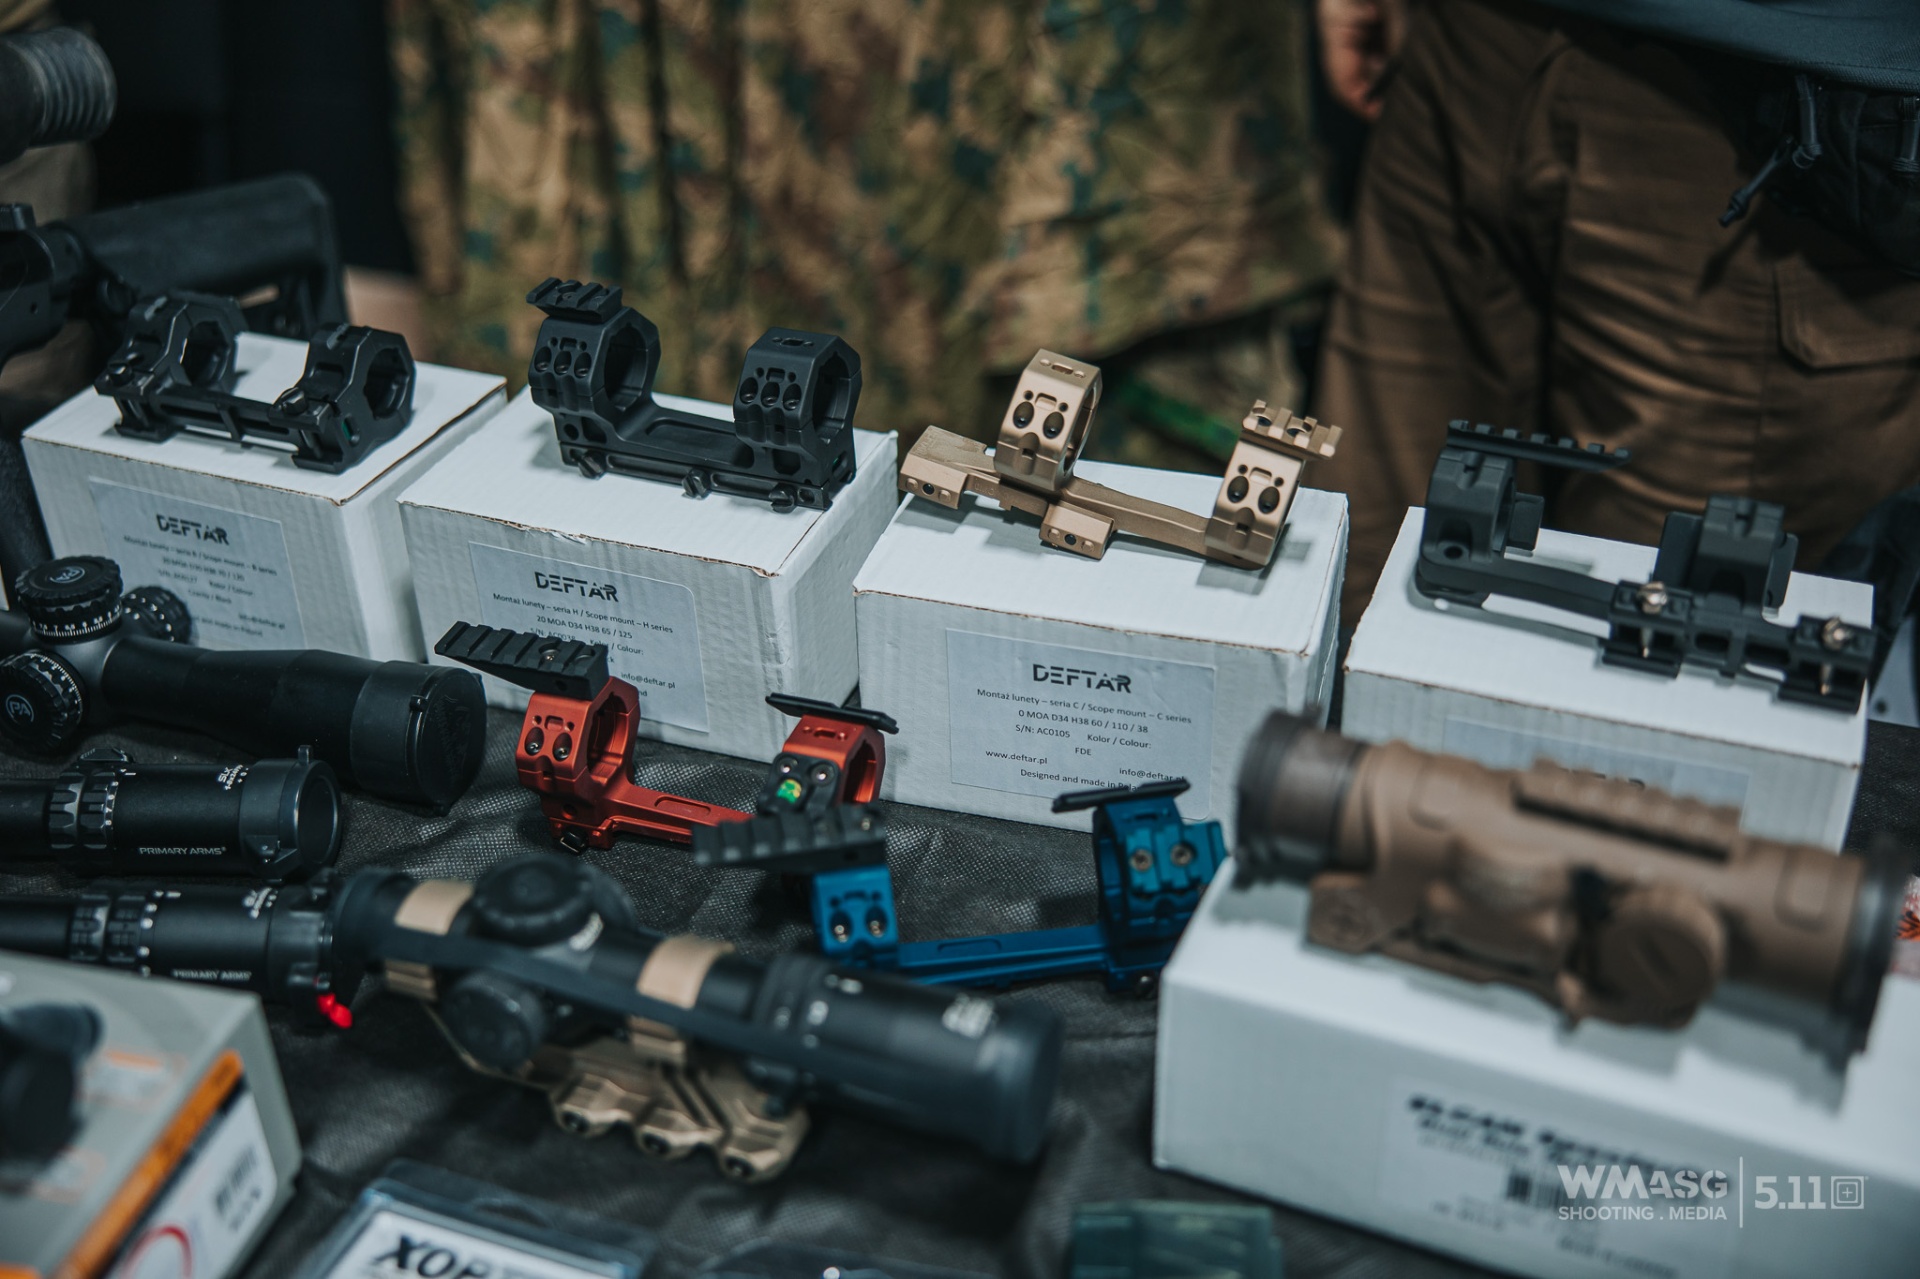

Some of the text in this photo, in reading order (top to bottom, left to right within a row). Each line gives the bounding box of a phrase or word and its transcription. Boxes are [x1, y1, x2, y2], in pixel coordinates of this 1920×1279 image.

[157, 514, 229, 546] DEFTAR
[535, 571, 619, 602] DEFTAR
[522, 599, 546, 610] lunety
[553, 606, 571, 614] seria
[586, 611, 608, 621] Scope
[610, 615, 635, 626] mount
[643, 621, 650, 629] H
[651, 624, 673, 633] series
[537, 615, 546, 623] 20
[547, 618, 566, 627] MOA
[568, 621, 583, 630] D34
[585, 624, 600, 633] H38
[619, 631, 632, 639] 125
[1033, 664, 1131, 693] DEFTAR
[977, 689, 1010, 700] Montaż
[1012, 694, 1040, 705] lunety
[1050, 700, 1071, 708] seria
[1088, 704, 1115, 714] Scope
[1117, 708, 1147, 718] mount
[1165, 715, 1192, 724] series
[1026, 711, 1049, 720] MOA
[1051, 714, 1069, 723] D34
[1071, 717, 1089, 726] H38
[1091, 719, 1103, 727] 60
[1112, 722, 1128, 731] 110
[1137, 725, 1148, 733] 38
[1015, 724, 1035, 733] S/N:
[1037, 727, 1071, 738] AC0105
[1087, 734, 1110, 743] Kolor
[1119, 738, 1152, 749] Colour:
[985, 750, 1048, 764] www.deftar.pl
[1075, 747, 1092, 756] FDE
[217, 767, 233, 783] SLX
[1020, 769, 1060, 780] Designed
[1081, 778, 1106, 787] made
[1107, 781, 1116, 789] in
[139, 847, 188, 855] PRIMARY
[172, 968, 219, 980] PRIMARY
